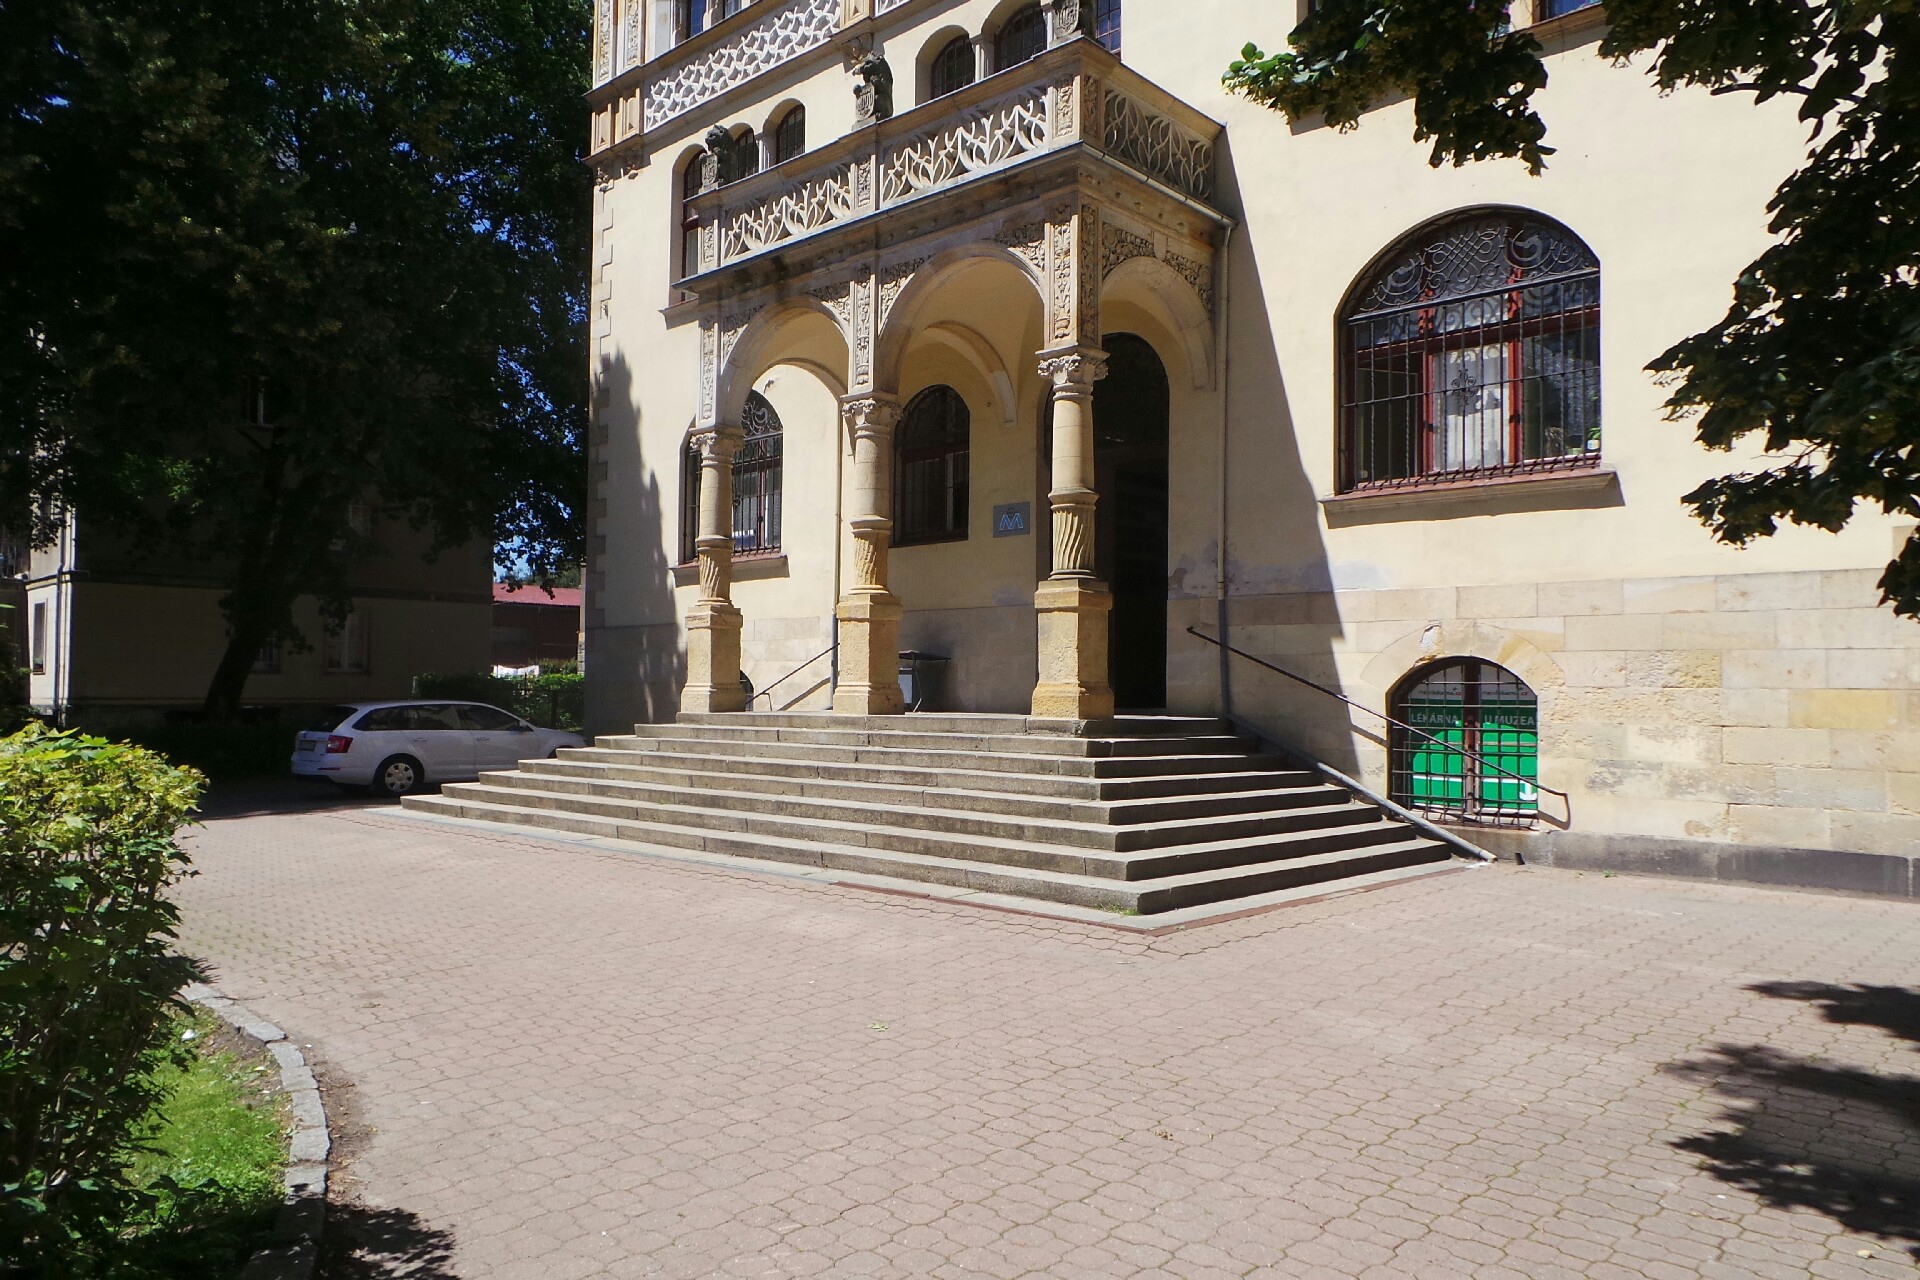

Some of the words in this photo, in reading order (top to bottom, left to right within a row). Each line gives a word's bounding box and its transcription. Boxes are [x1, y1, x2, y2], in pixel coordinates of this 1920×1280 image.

[1411, 712, 1458, 724] LÉKÁRNA
[1484, 714, 1493, 724] U
[1494, 715, 1535, 726] MUZEA
